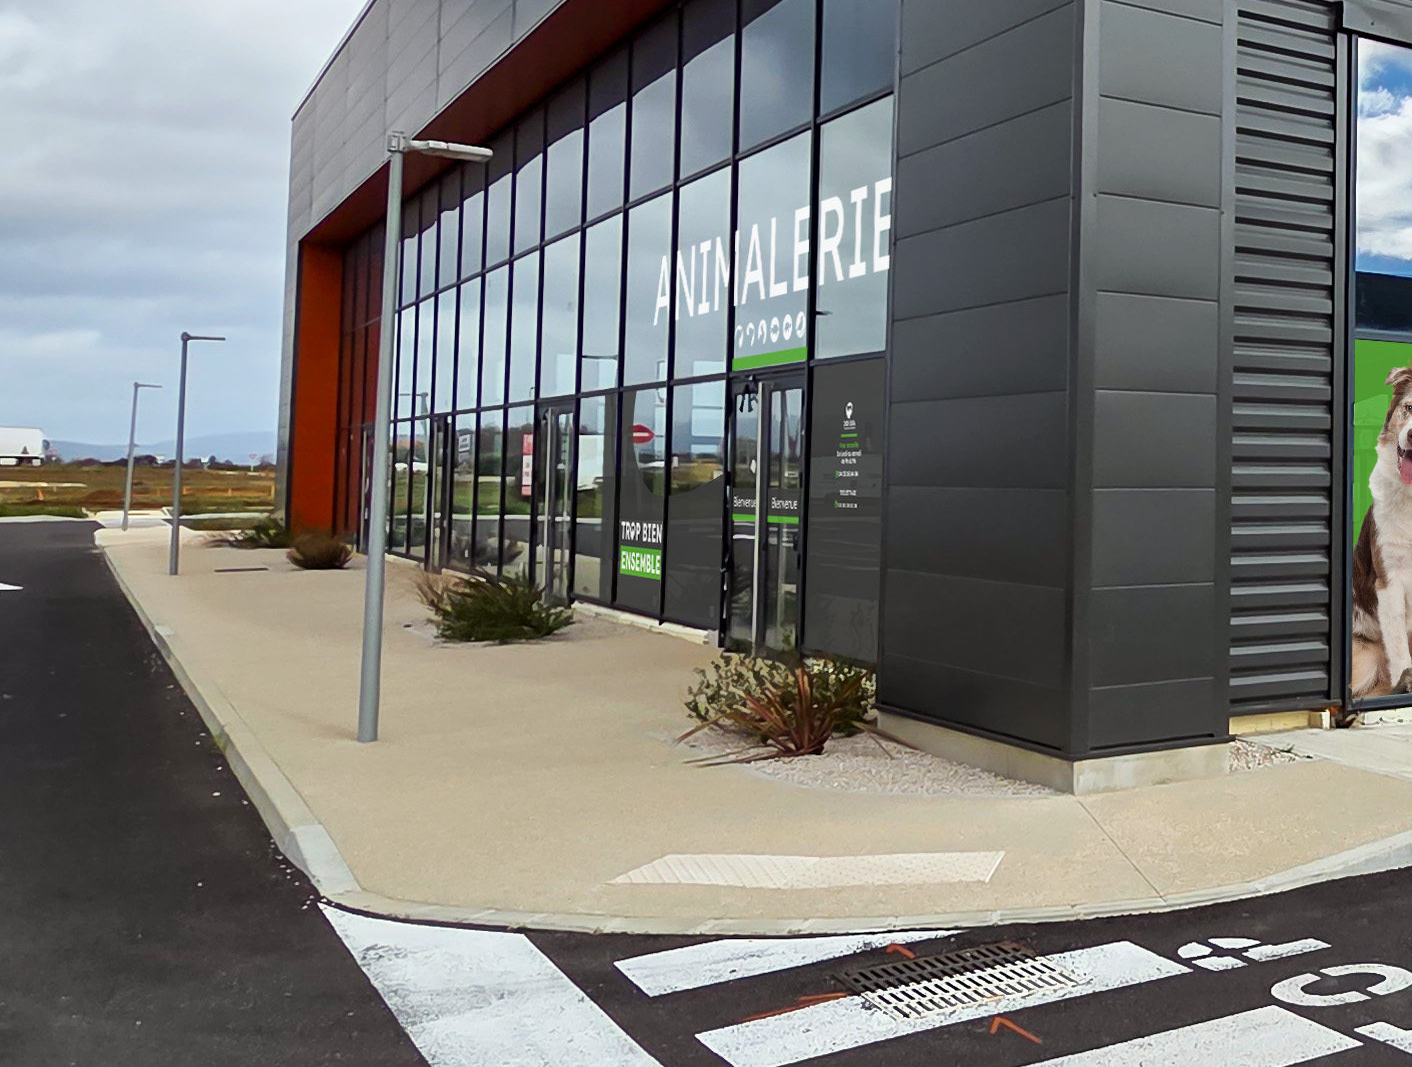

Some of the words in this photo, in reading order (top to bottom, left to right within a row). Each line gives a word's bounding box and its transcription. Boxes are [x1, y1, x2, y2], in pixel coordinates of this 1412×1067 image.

[653, 177, 892, 326] ANIMALERIE
[621, 521, 641, 541] TROP
[642, 522, 663, 544] BIEN
[621, 551, 661, 574] ENSEMBLE
